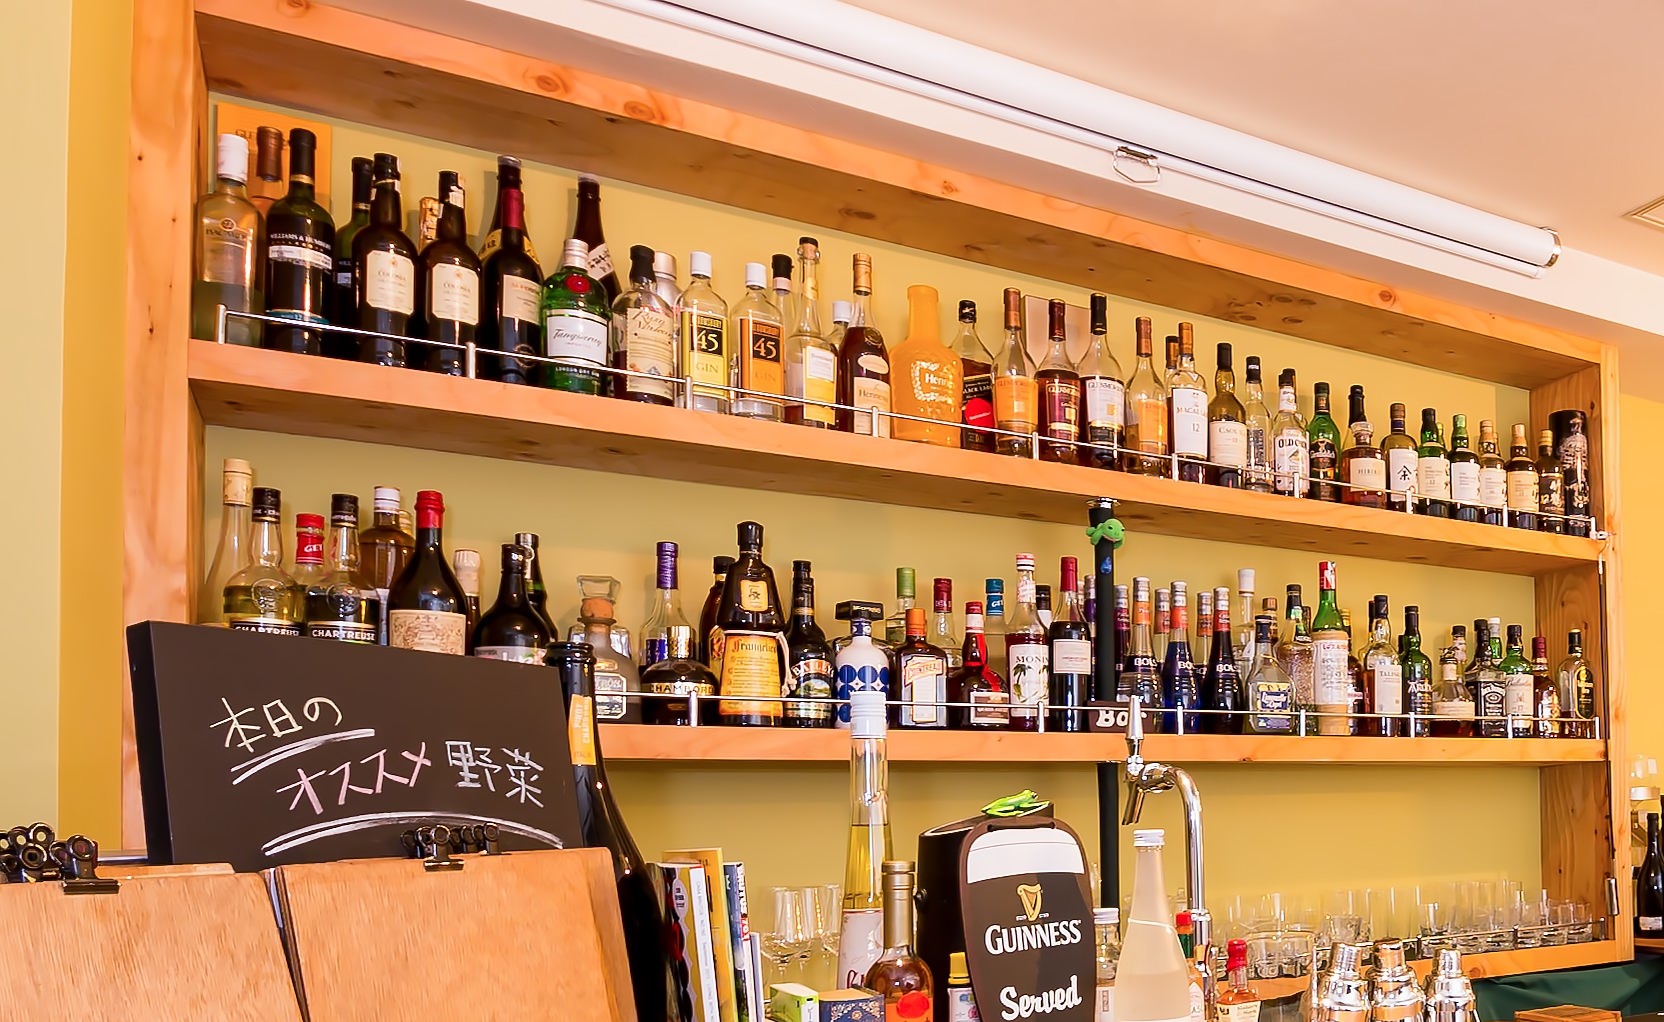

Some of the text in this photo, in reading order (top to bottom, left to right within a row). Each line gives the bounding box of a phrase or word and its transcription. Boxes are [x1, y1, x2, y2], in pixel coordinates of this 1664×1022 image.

[697, 330, 719, 351] 45
[753, 337, 777, 359] 45
[696, 361, 719, 374] GIN
[1192, 423, 1201, 433] 12
[1278, 438, 1294, 449] OLD
[312, 629, 375, 641] CHARTREUSE
[1134, 657, 1157, 667] BOLS
[210, 697, 343, 753] 本日の
[984, 920, 1082, 955] GUINNESS
[1000, 974, 1083, 1021] Served
